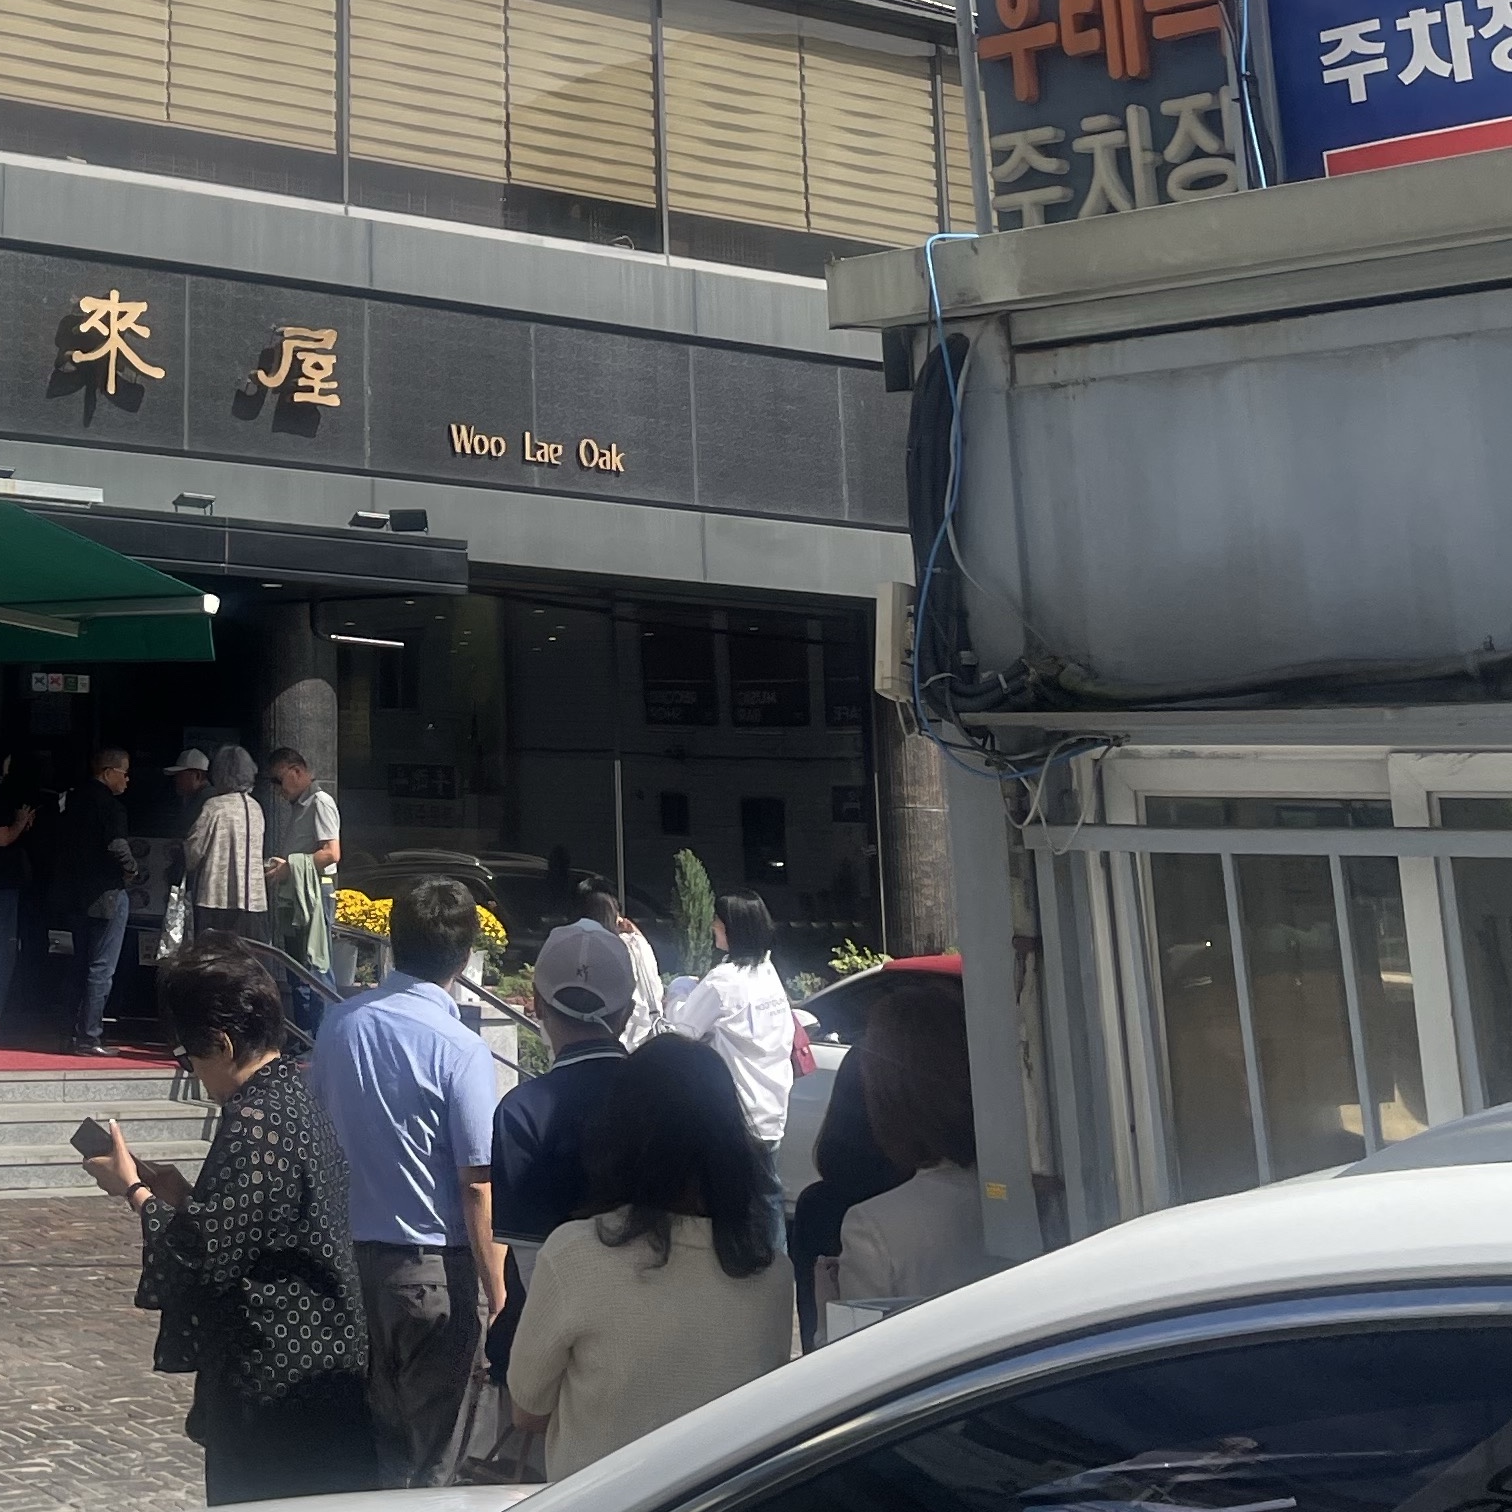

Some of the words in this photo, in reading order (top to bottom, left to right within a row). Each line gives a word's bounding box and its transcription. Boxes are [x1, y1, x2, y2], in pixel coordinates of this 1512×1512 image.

[450, 423, 507, 457] Woo
[523, 431, 563, 465] Lae
[579, 439, 626, 473] Oak
